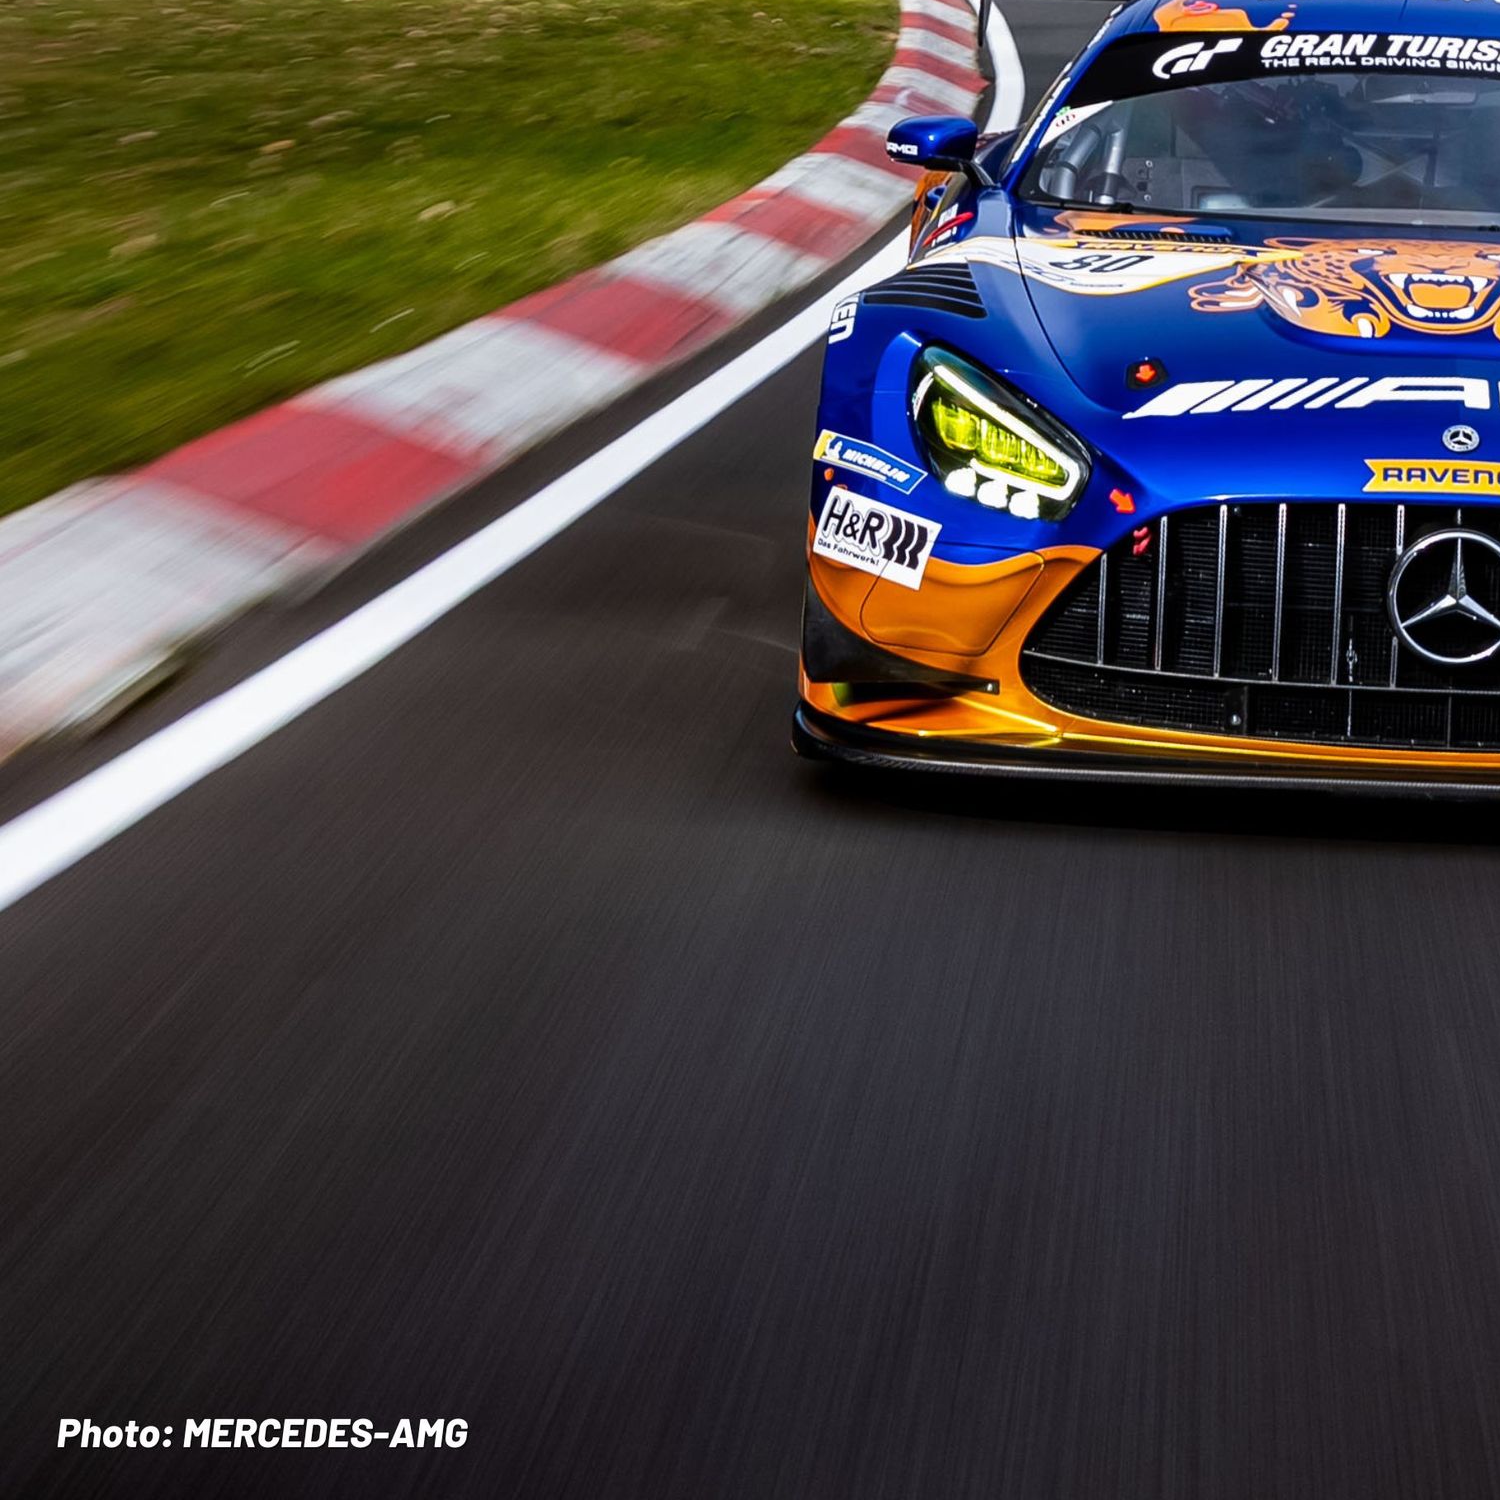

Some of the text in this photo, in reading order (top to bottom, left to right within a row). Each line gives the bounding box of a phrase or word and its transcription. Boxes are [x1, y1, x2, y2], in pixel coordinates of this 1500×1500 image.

[1260, 34, 1377, 58] GRAN
[1261, 58, 1300, 69] THE
[1308, 57, 1357, 67] REAL
[1365, 57, 1441, 69] DRIVING
[1049, 254, 1155, 273] 80
[842, 448, 911, 483] MICHELIN
[823, 495, 885, 549] H&R
[817, 538, 832, 550] Das
